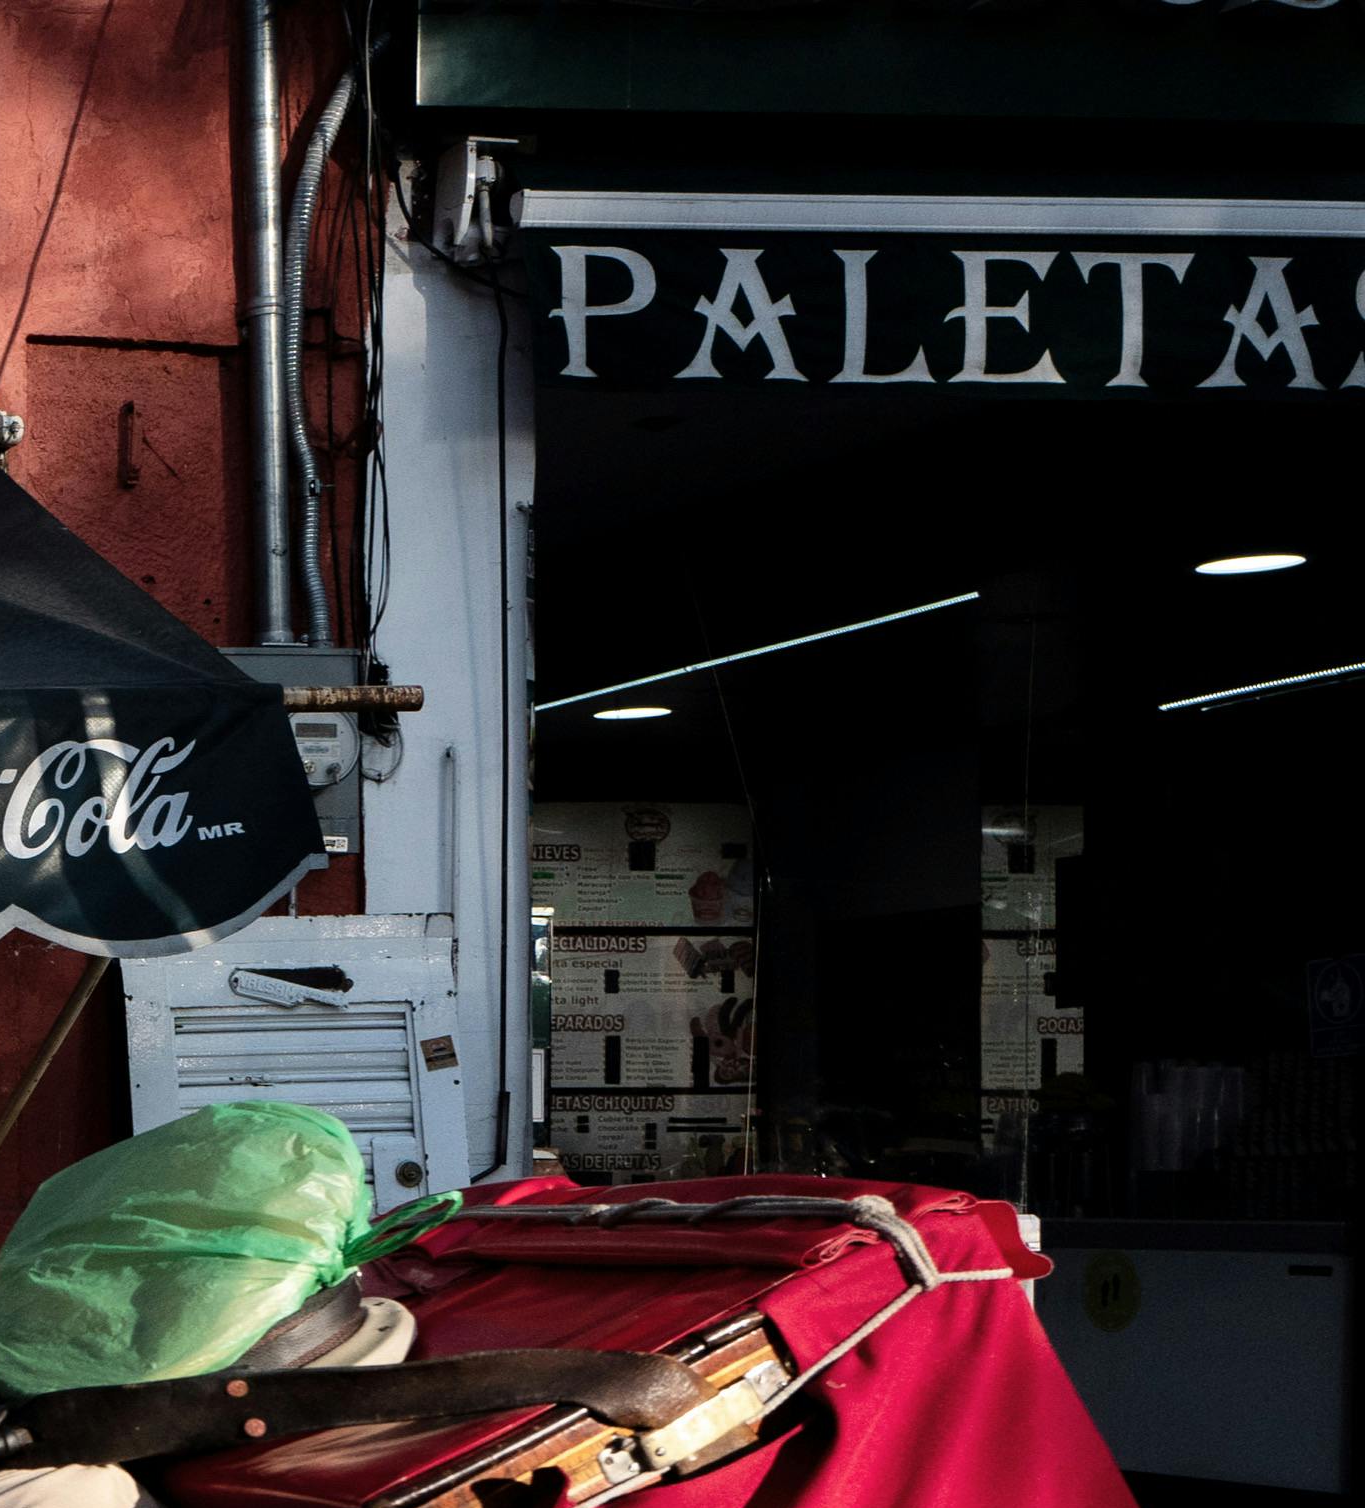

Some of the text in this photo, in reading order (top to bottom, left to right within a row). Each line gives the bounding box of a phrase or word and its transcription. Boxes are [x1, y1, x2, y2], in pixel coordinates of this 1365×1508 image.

[197, 821, 246, 842] MR
[572, 959, 623, 970] especial
[571, 995, 599, 1007] light
[593, 1095, 675, 1114] CHIQUITAS
[583, 1154, 603, 1171] DE
[605, 1153, 662, 1171] FRUTAS
